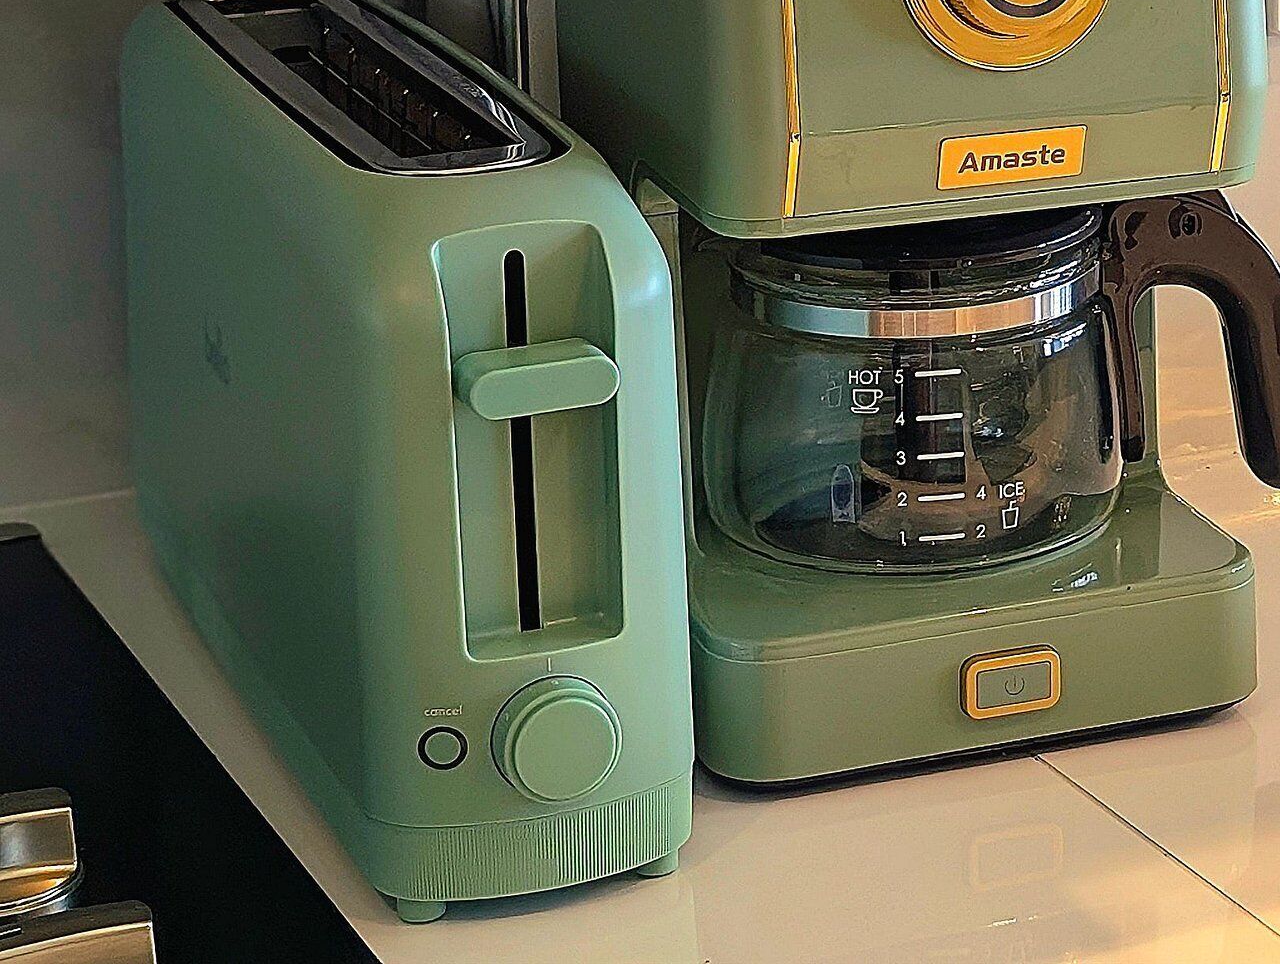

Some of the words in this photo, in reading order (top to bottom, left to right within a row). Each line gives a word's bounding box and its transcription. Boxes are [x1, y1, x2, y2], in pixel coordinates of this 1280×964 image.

[957, 144, 1066, 174] Amaste
[848, 369, 882, 385] HOT
[894, 369, 904, 385] 5
[895, 412, 905, 426] 4
[896, 451, 906, 465] 3
[897, 492, 908, 507] 2
[976, 485, 987, 500] 4
[999, 481, 1024, 499] ICE
[975, 524, 986, 539] 2
[424, 704, 462, 718] cancel
